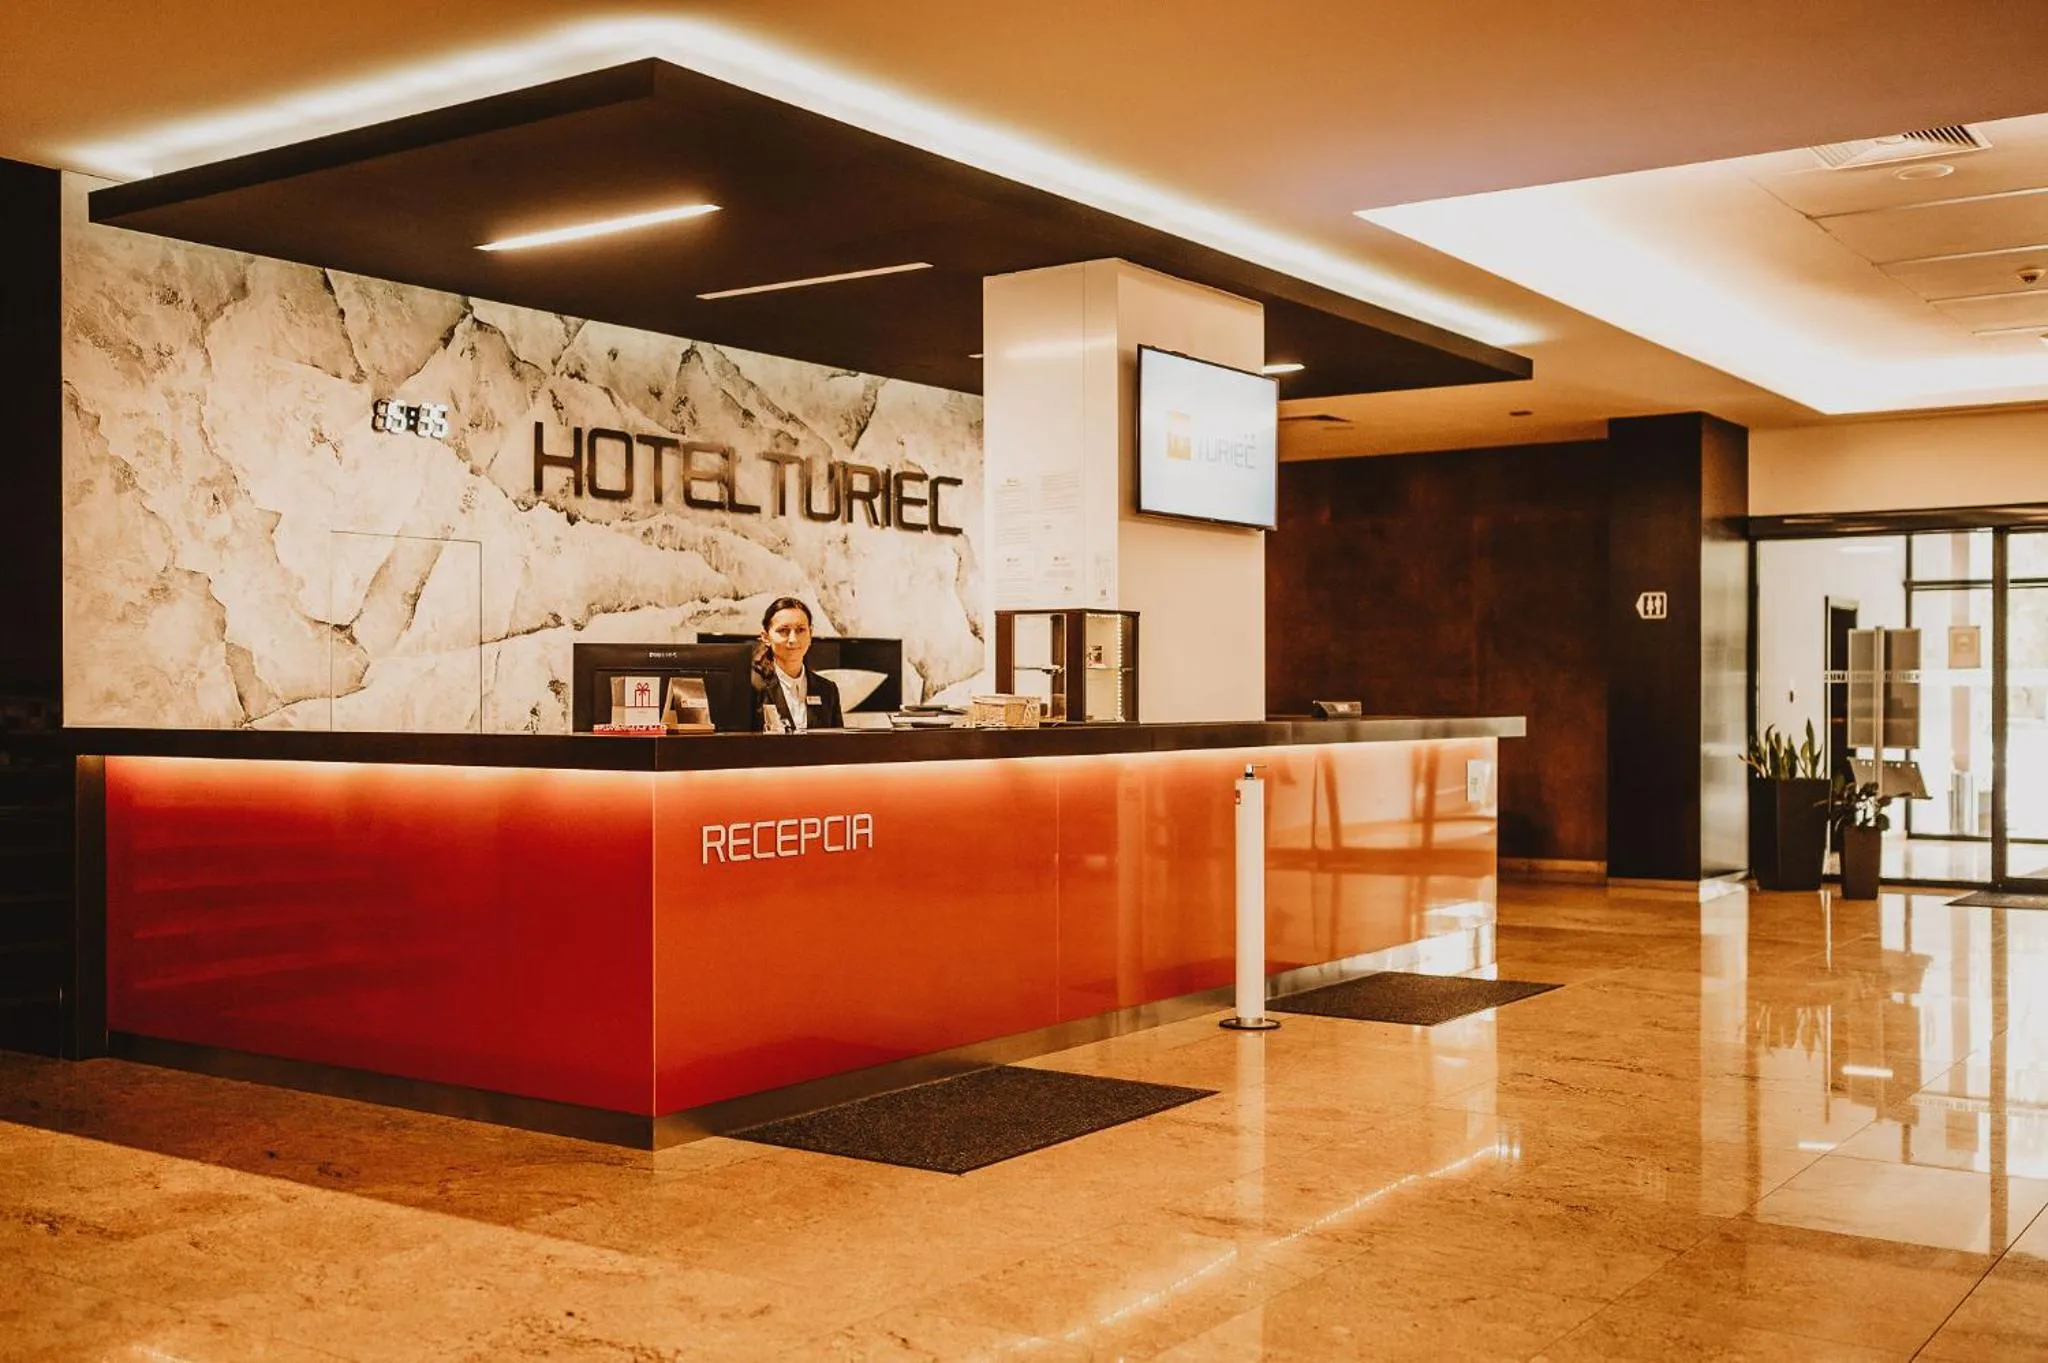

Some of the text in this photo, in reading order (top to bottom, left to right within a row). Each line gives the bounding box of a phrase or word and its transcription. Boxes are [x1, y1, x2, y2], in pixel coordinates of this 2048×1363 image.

[533, 421, 761, 514] HOTEL
[758, 452, 964, 534] TURIEC
[702, 813, 874, 865] RECEPCIA
